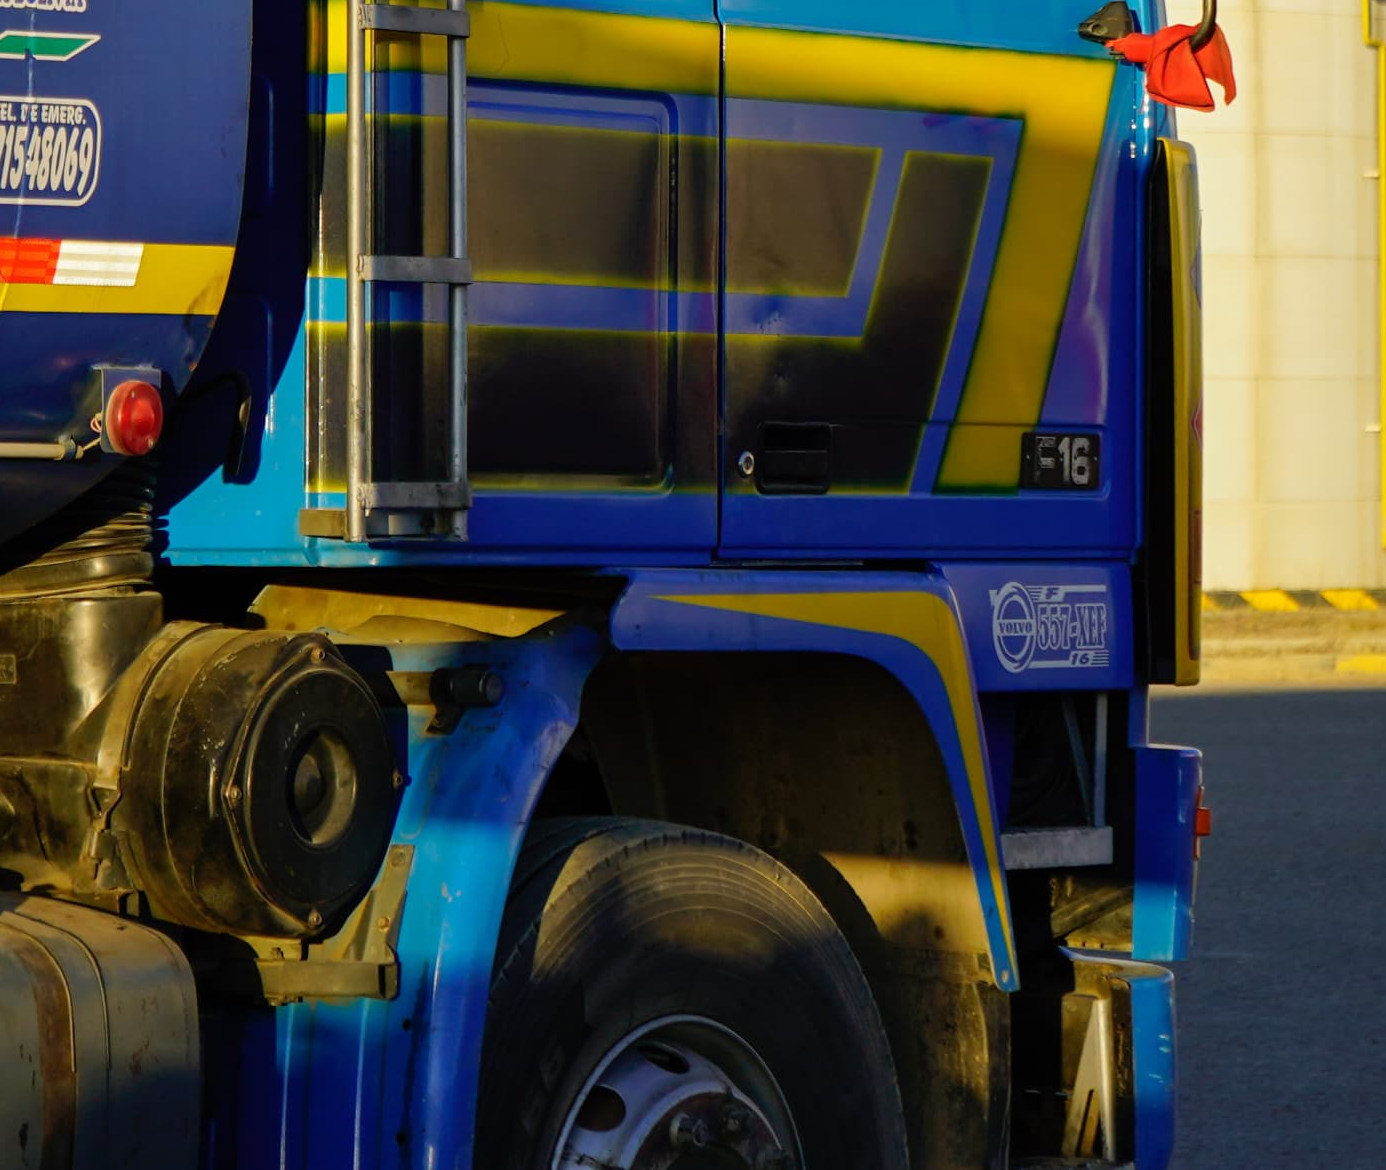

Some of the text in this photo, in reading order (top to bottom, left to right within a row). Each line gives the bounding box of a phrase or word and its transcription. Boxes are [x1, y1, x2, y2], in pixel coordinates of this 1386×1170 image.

[41, 104, 87, 126] EMERG.
[998, 620, 1034, 635] VOLVO
[1070, 652, 1091, 666] 16
